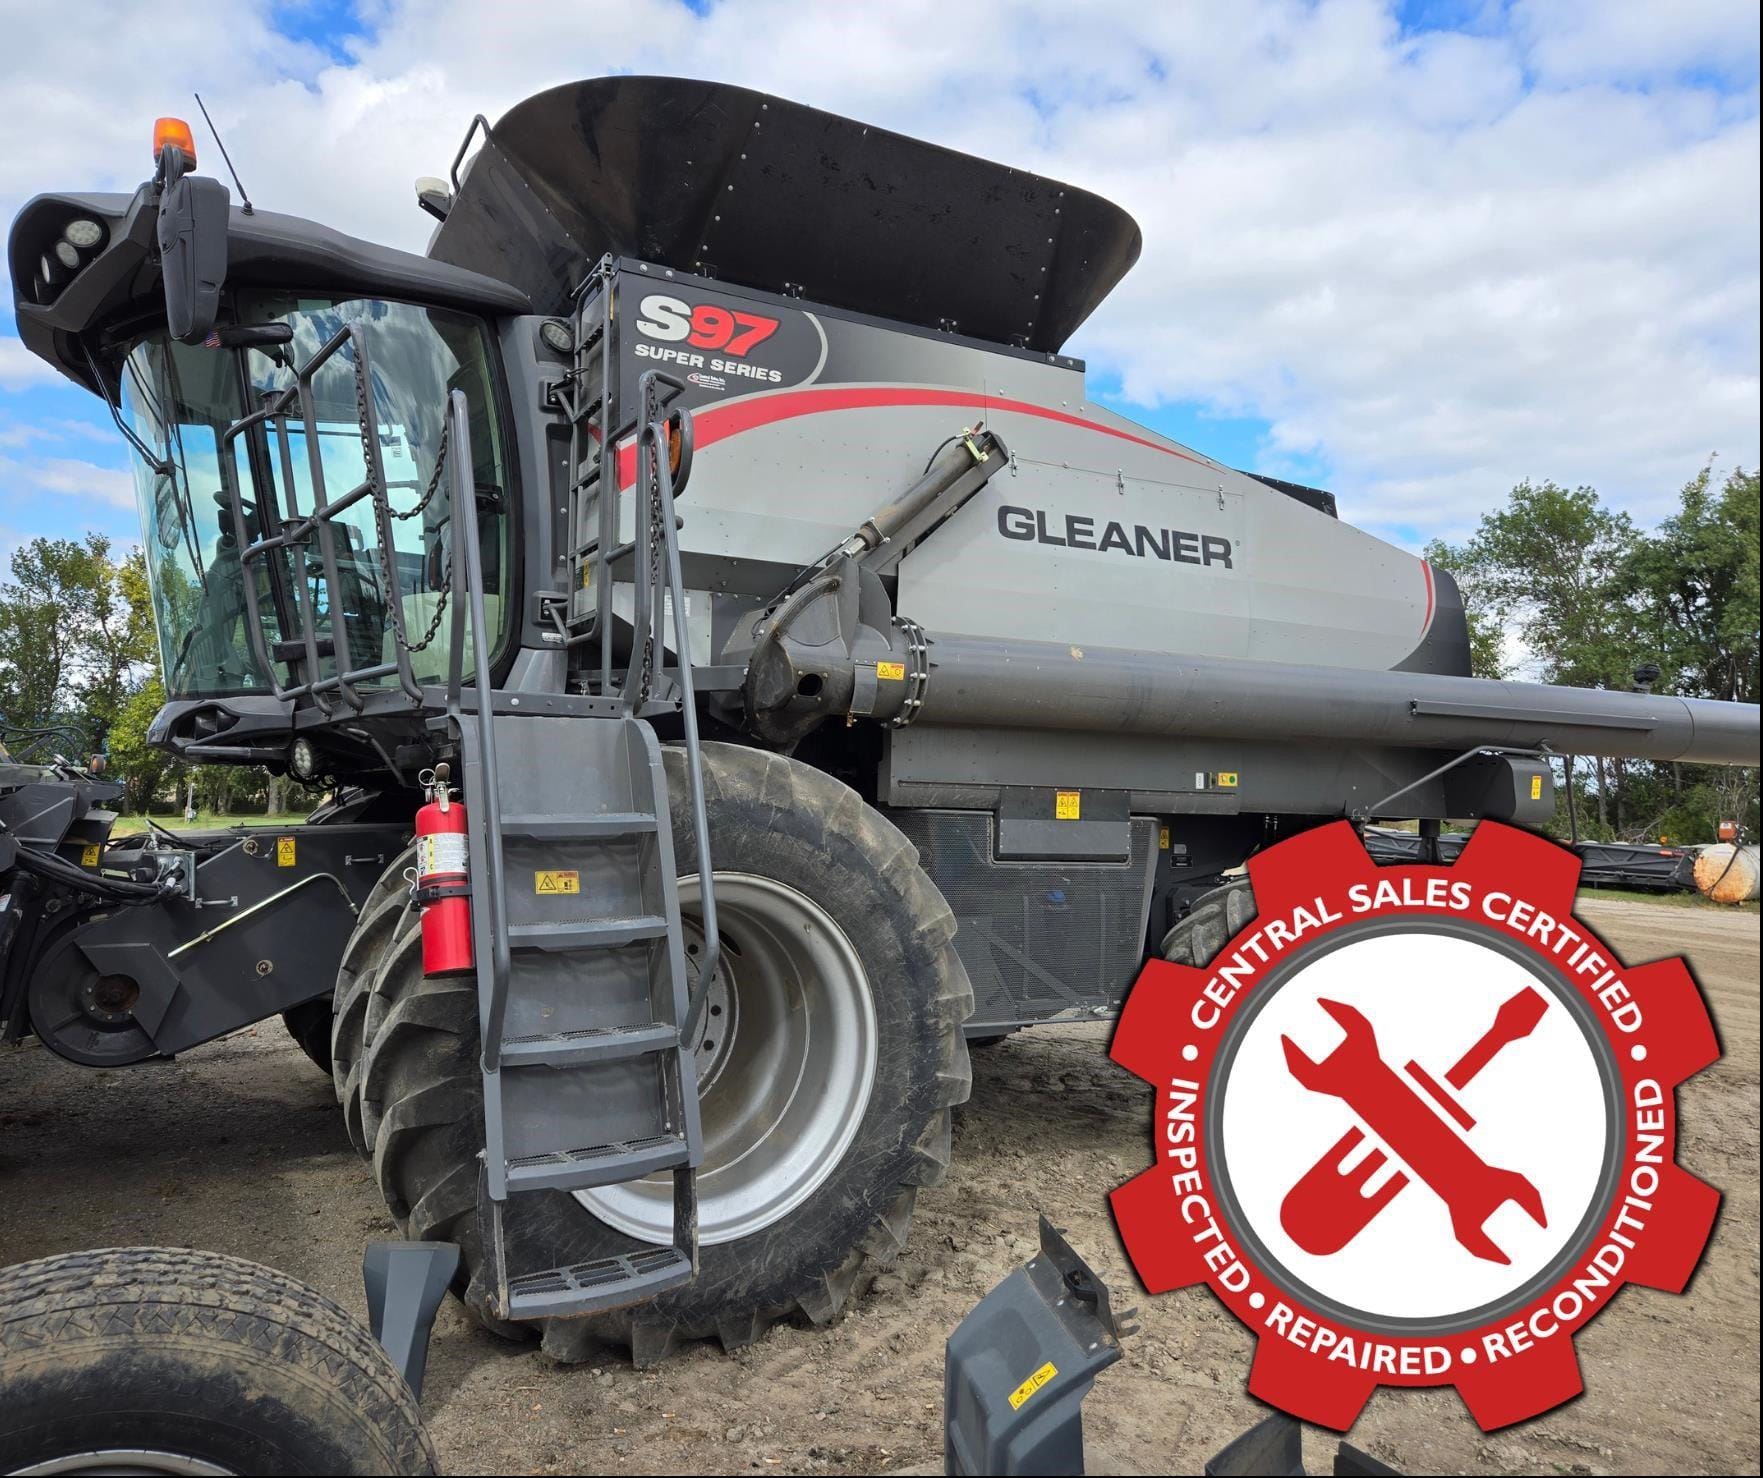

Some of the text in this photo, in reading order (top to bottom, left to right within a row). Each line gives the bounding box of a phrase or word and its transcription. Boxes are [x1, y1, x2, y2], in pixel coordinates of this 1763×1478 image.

[636, 295, 780, 357] S97
[634, 343, 704, 368] SUPER
[710, 359, 782, 382] SERIES
[997, 505, 1233, 569] GLEANER
